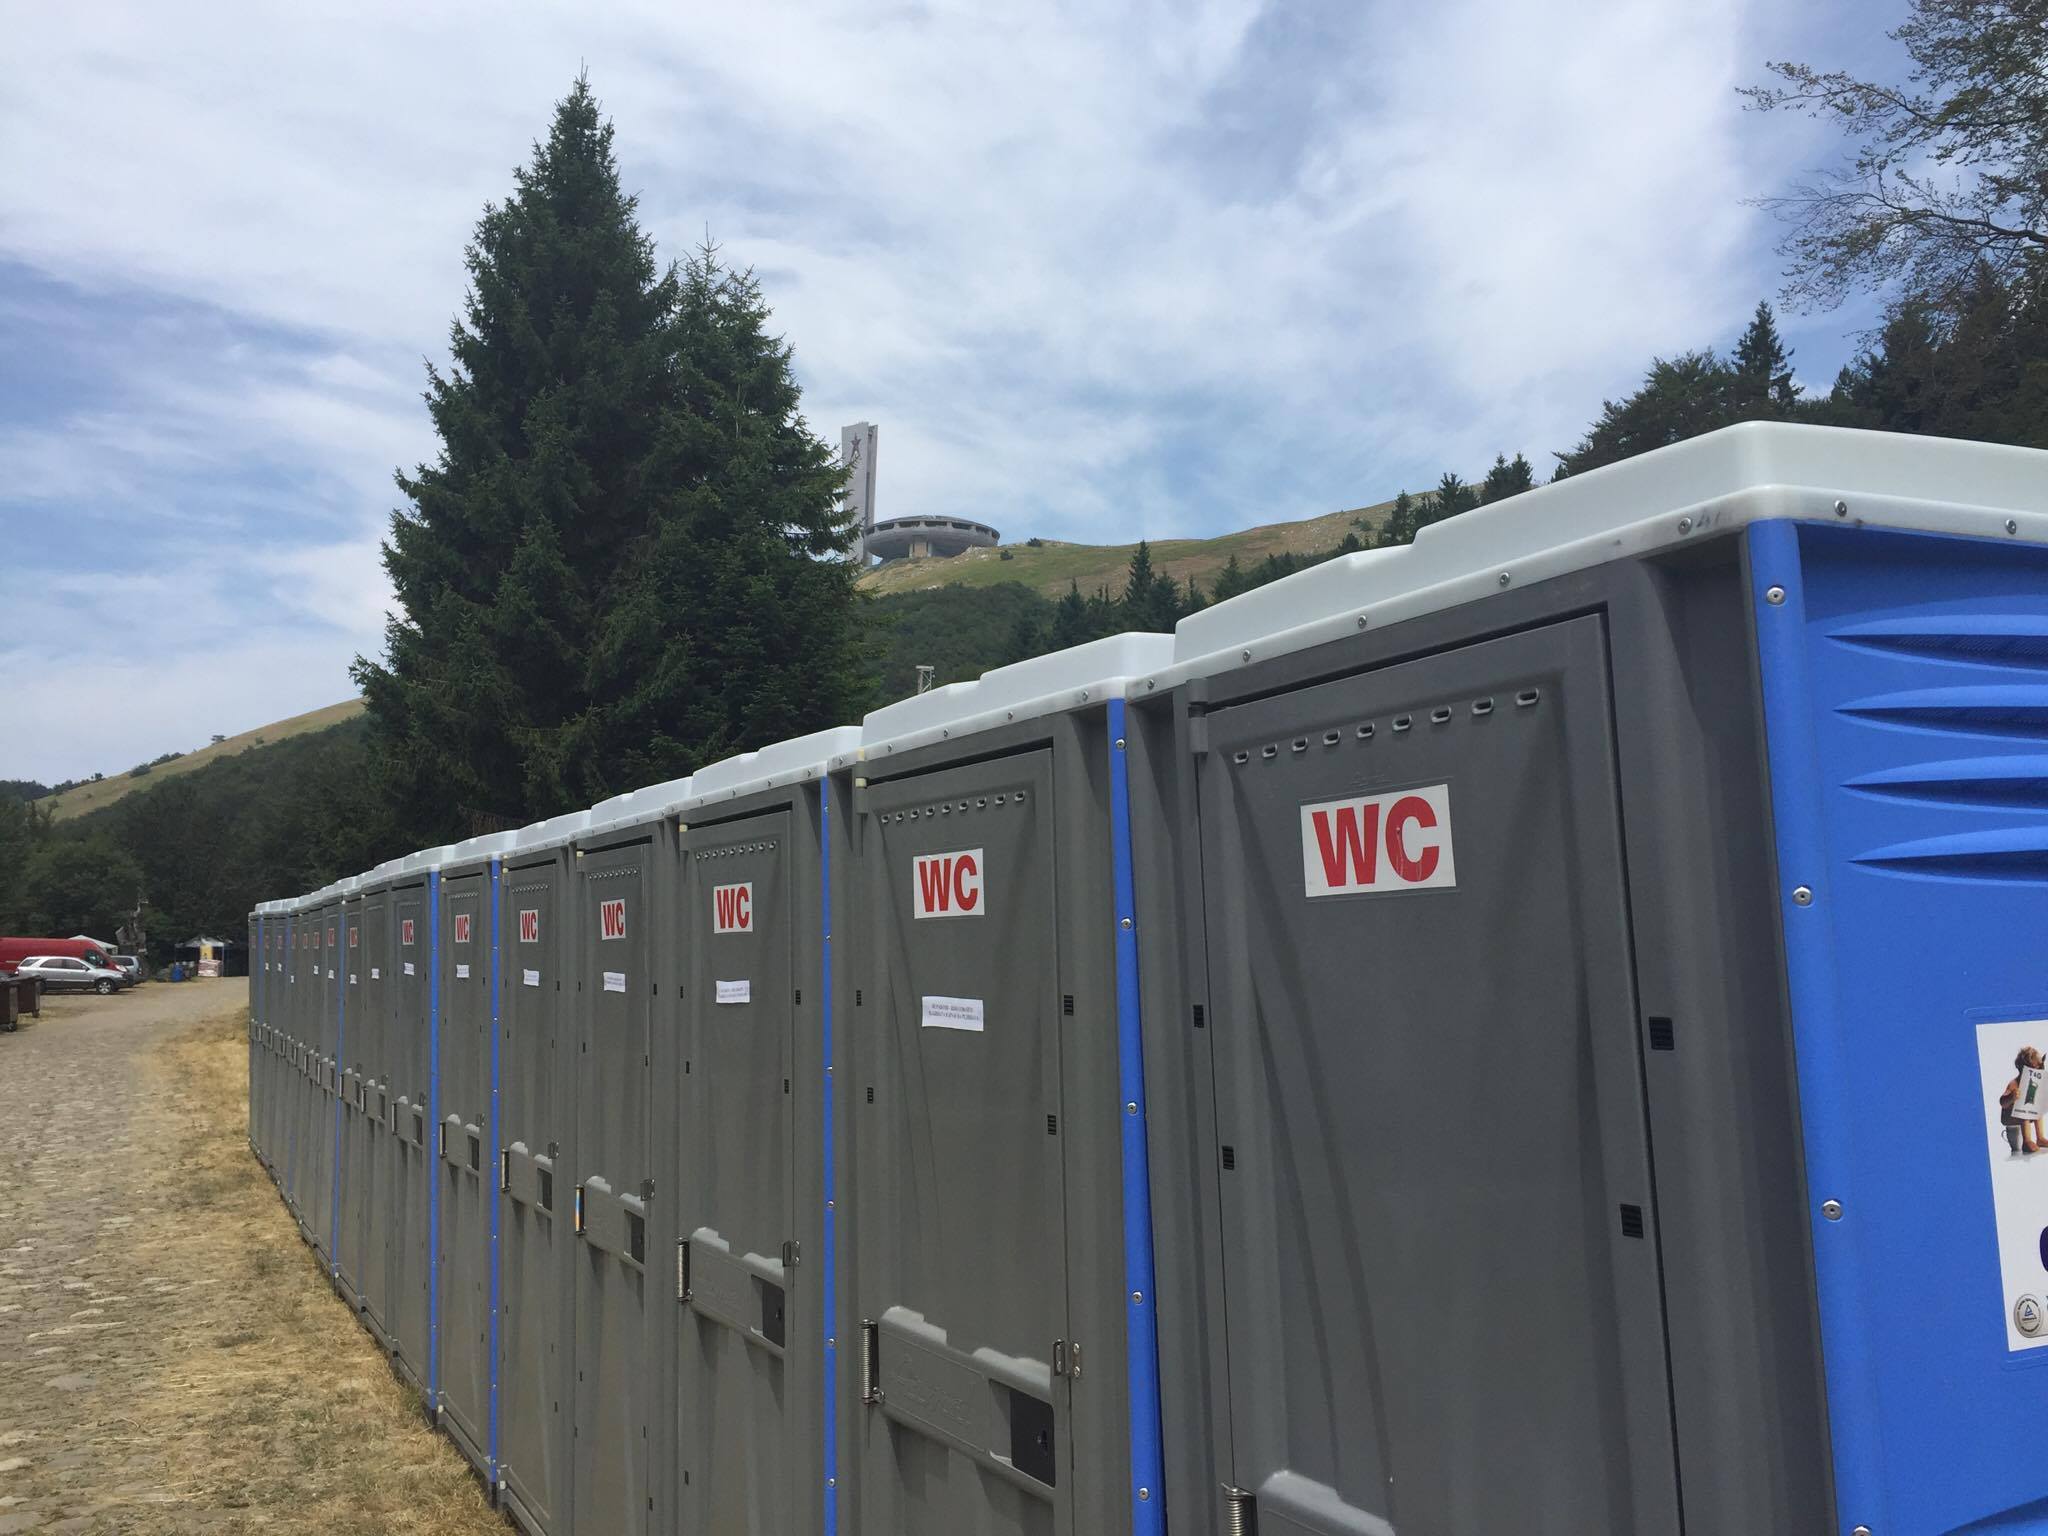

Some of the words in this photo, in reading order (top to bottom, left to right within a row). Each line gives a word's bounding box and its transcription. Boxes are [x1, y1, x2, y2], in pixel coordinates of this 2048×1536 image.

[1311, 795, 1440, 888] WC
[918, 854, 979, 913] WC
[521, 912, 538, 940] WC
[602, 902, 625, 936] WC
[715, 886, 751, 929] WC
[456, 917, 469, 941] WC
